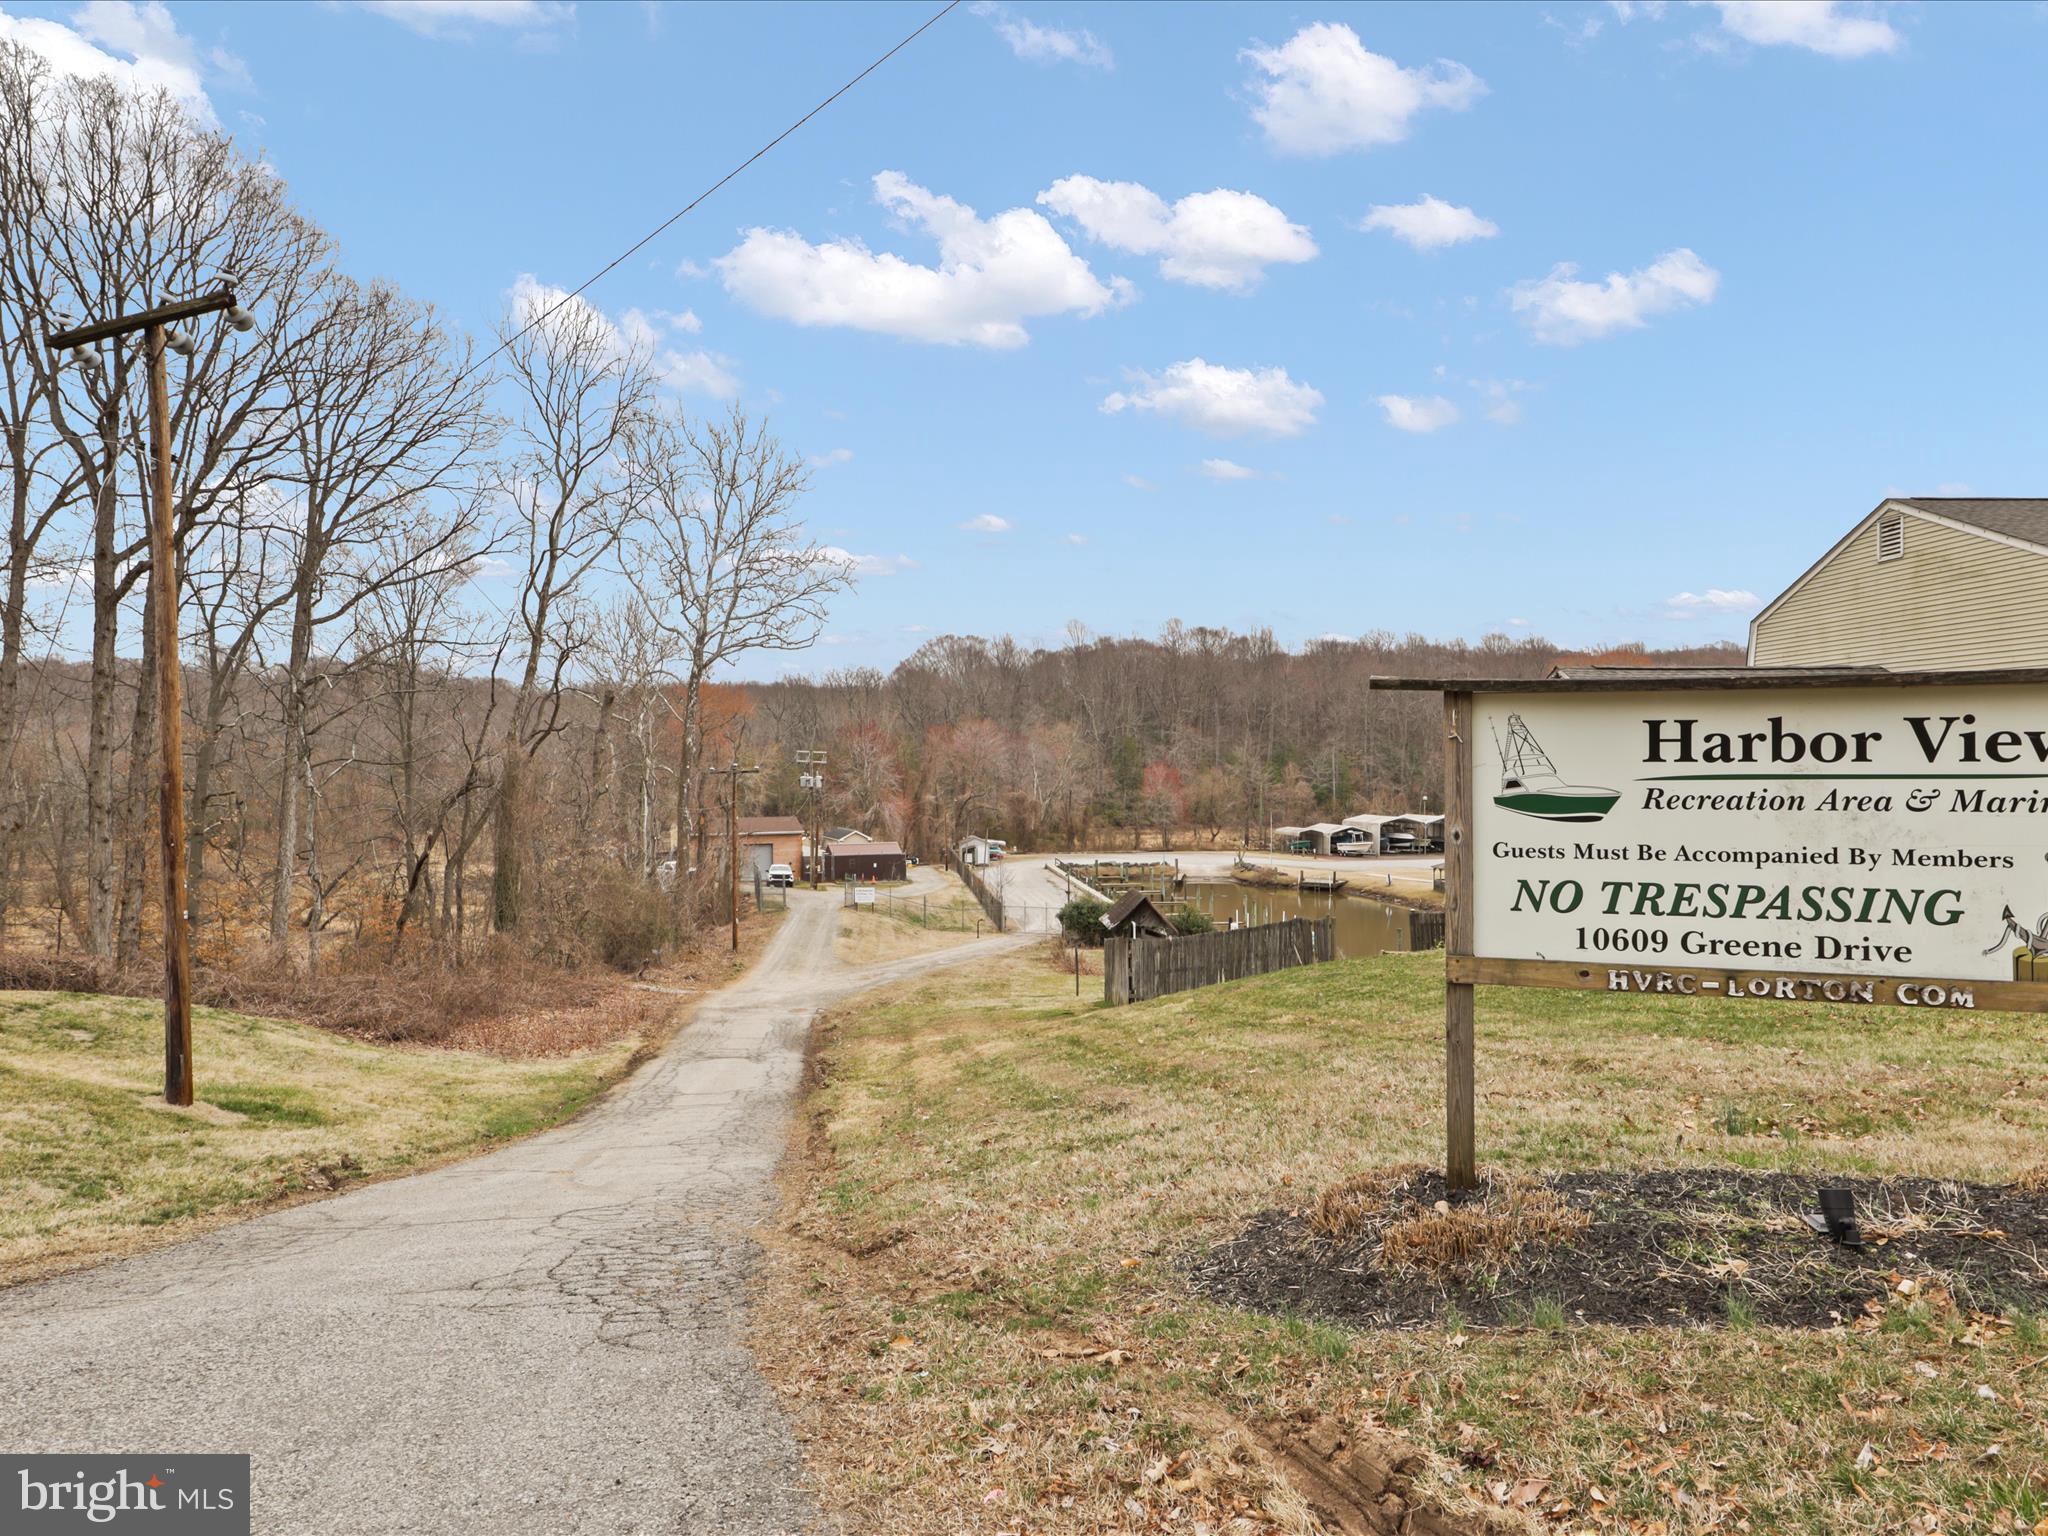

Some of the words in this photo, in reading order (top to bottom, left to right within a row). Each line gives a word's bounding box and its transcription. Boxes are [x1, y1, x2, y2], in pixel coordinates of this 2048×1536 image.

[1642, 715, 1882, 764] Harbor
[1641, 787, 1805, 812] Recreation
[1815, 788, 1893, 813] Area
[1905, 788, 1941, 813] &
[1492, 841, 1566, 861] Guests
[1573, 843, 1630, 862] Must
[1637, 844, 1667, 862] Be
[1674, 844, 1839, 870] Accompanied
[1848, 847, 1882, 872] By
[1891, 848, 2014, 869] Members
[1509, 879, 1584, 914] NO
[1596, 881, 1965, 926] TRESPASSING
[1576, 927, 1669, 953] 10609
[1680, 931, 1802, 960] Greene
[1814, 935, 1913, 964] Drive
